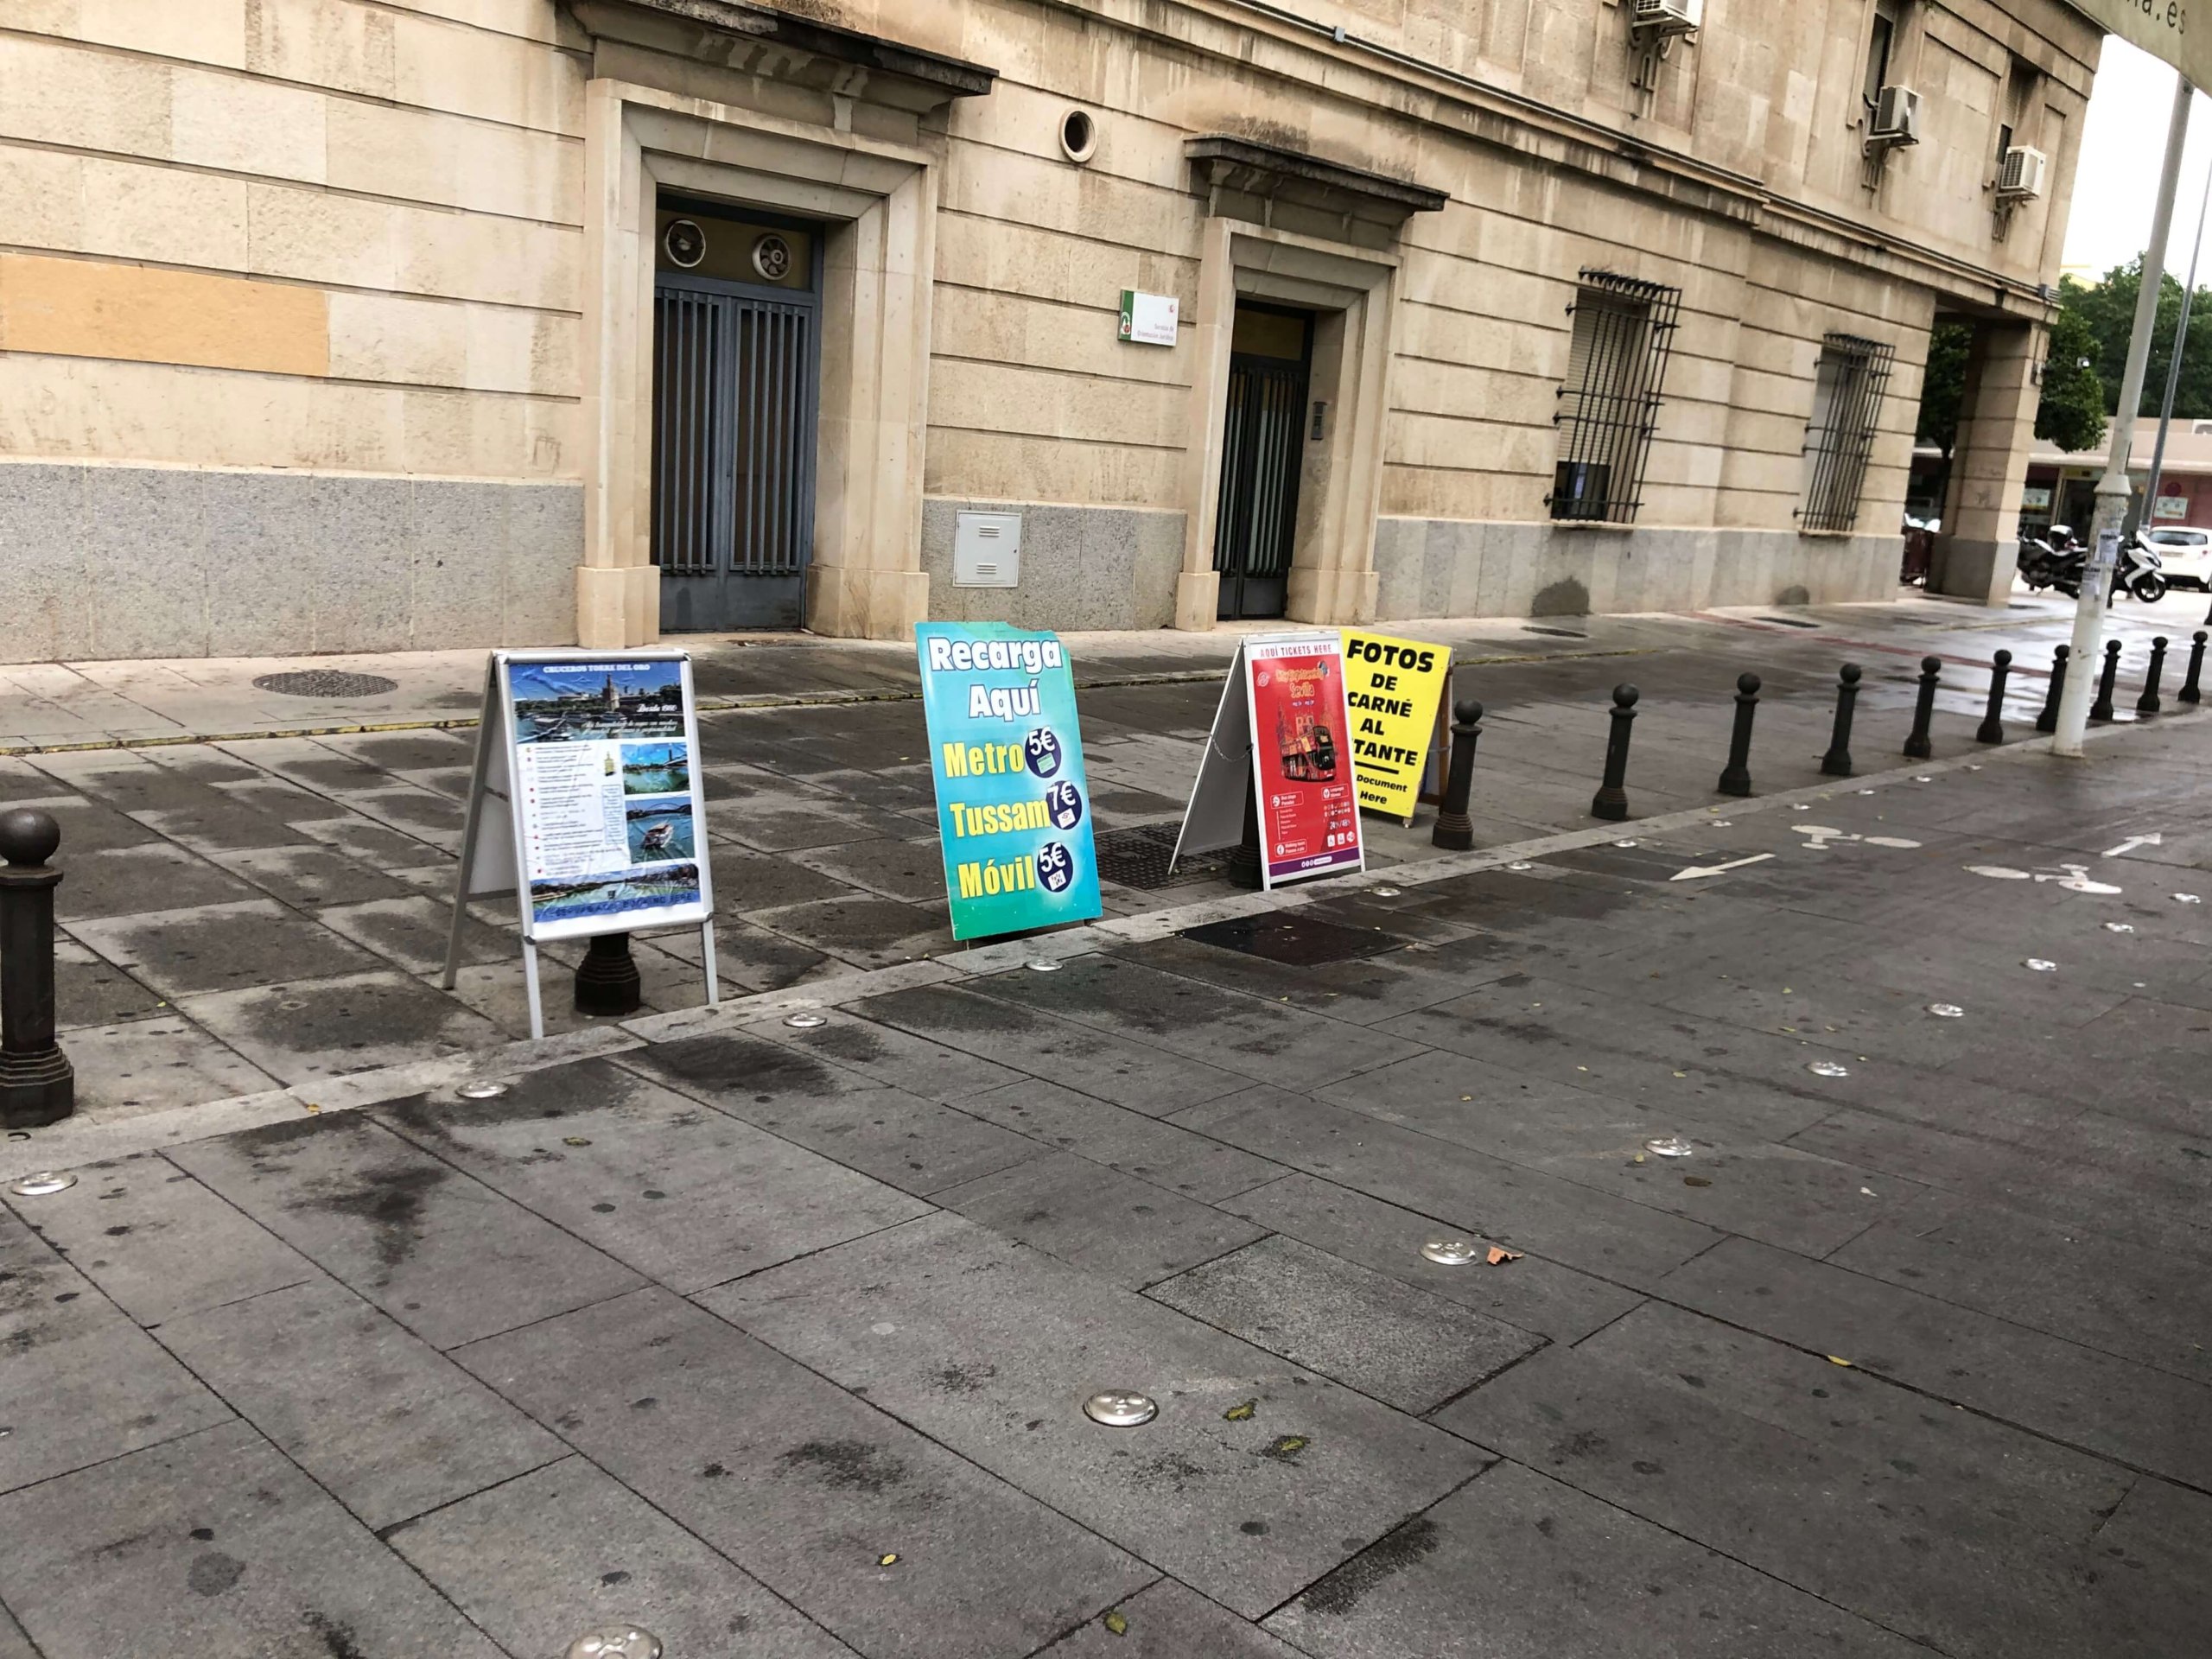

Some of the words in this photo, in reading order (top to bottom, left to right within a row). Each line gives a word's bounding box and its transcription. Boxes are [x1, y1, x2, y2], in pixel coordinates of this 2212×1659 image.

[928, 637, 1063, 674] Recarga
[1281, 645, 1312, 656] TICKETS
[1313, 644, 1332, 653] HERE
[1347, 639, 1434, 672] FOTOS
[1289, 681, 1315, 698] Sevilla
[1370, 673, 1397, 691] DE
[969, 678, 1041, 722] Aquí
[1348, 692, 1413, 717] CARNÉ
[1360, 718, 1384, 736] AL
[943, 742, 1026, 778] Metro
[1028, 726, 1055, 756] 5€
[1352, 738, 1418, 766] TANTE
[1357, 774, 1408, 792] Document
[949, 799, 1052, 838] Tussam
[1047, 781, 1077, 811] 7€
[1360, 791, 1388, 804] Here
[957, 855, 1036, 899] Móvil
[1039, 842, 1066, 873] 5€
